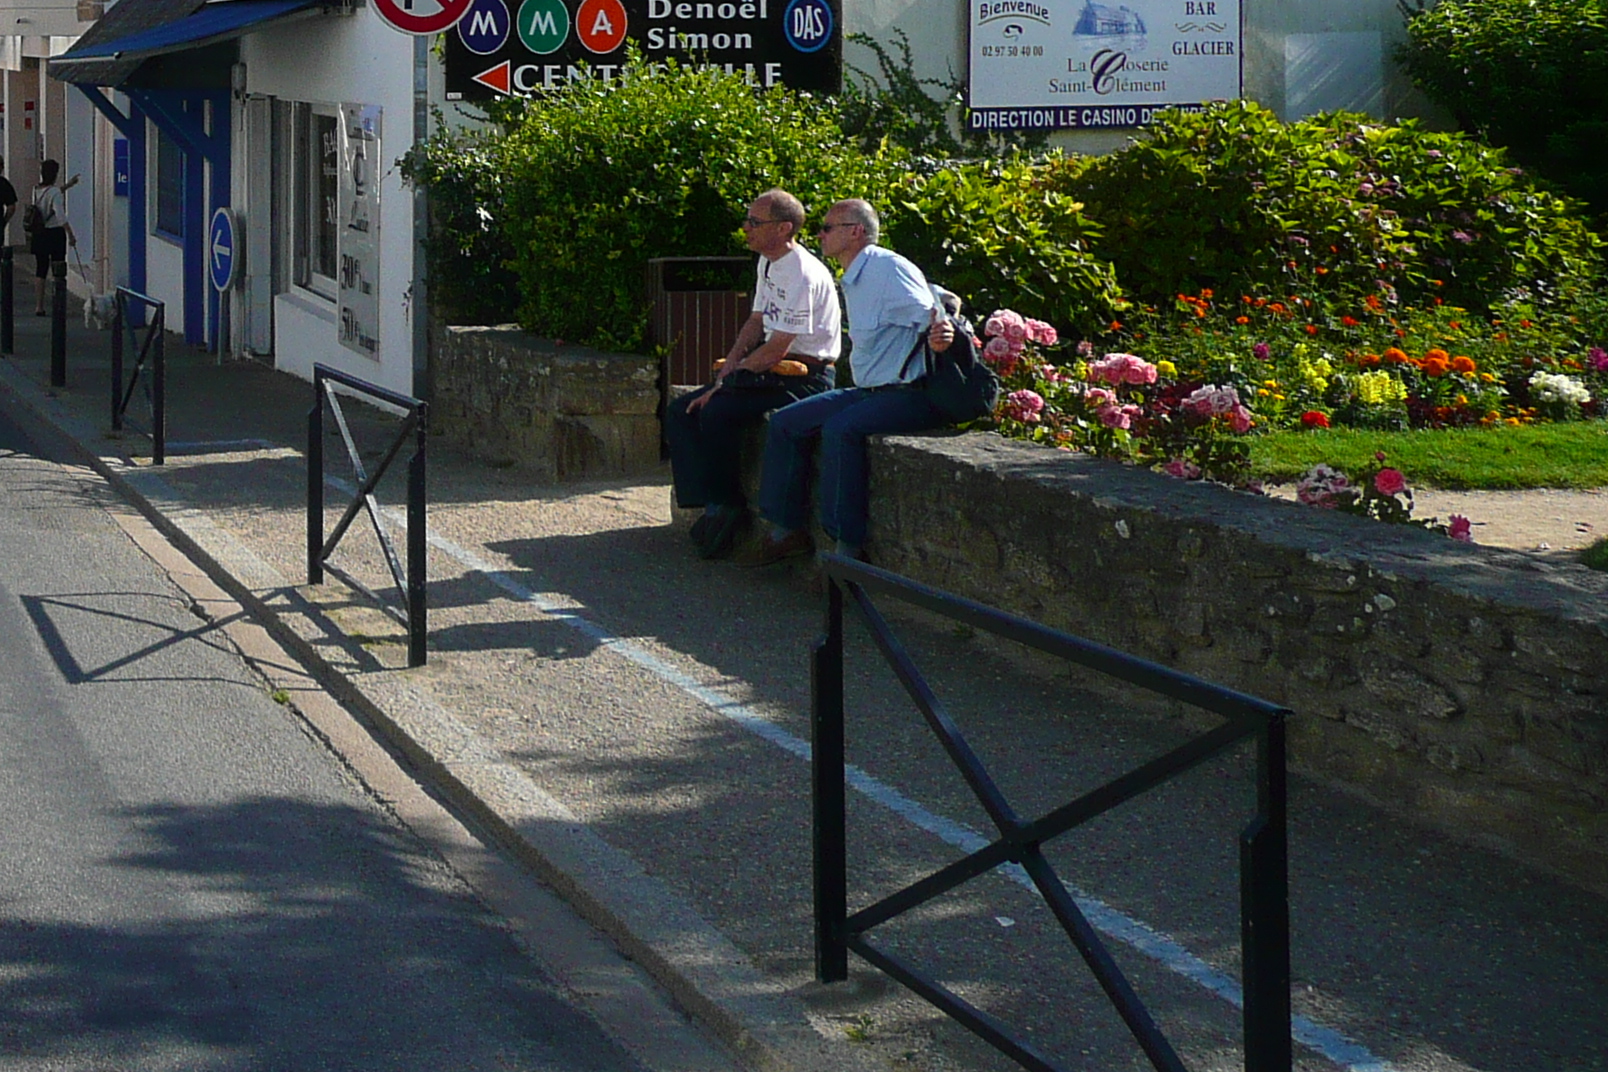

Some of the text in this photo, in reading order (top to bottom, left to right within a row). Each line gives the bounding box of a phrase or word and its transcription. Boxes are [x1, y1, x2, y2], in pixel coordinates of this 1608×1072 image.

[979, 0, 1050, 20] Bienvenue
[1185, 1, 1217, 16] BAR
[794, 5, 825, 40] DAS
[647, 26, 753, 50] Simon
[1172, 41, 1235, 56] GLACIER
[1067, 58, 1086, 73] La
[972, 109, 1055, 128] DIRECTION
[1059, 108, 1078, 126] LE
[1081, 106, 1137, 126] CASINO
